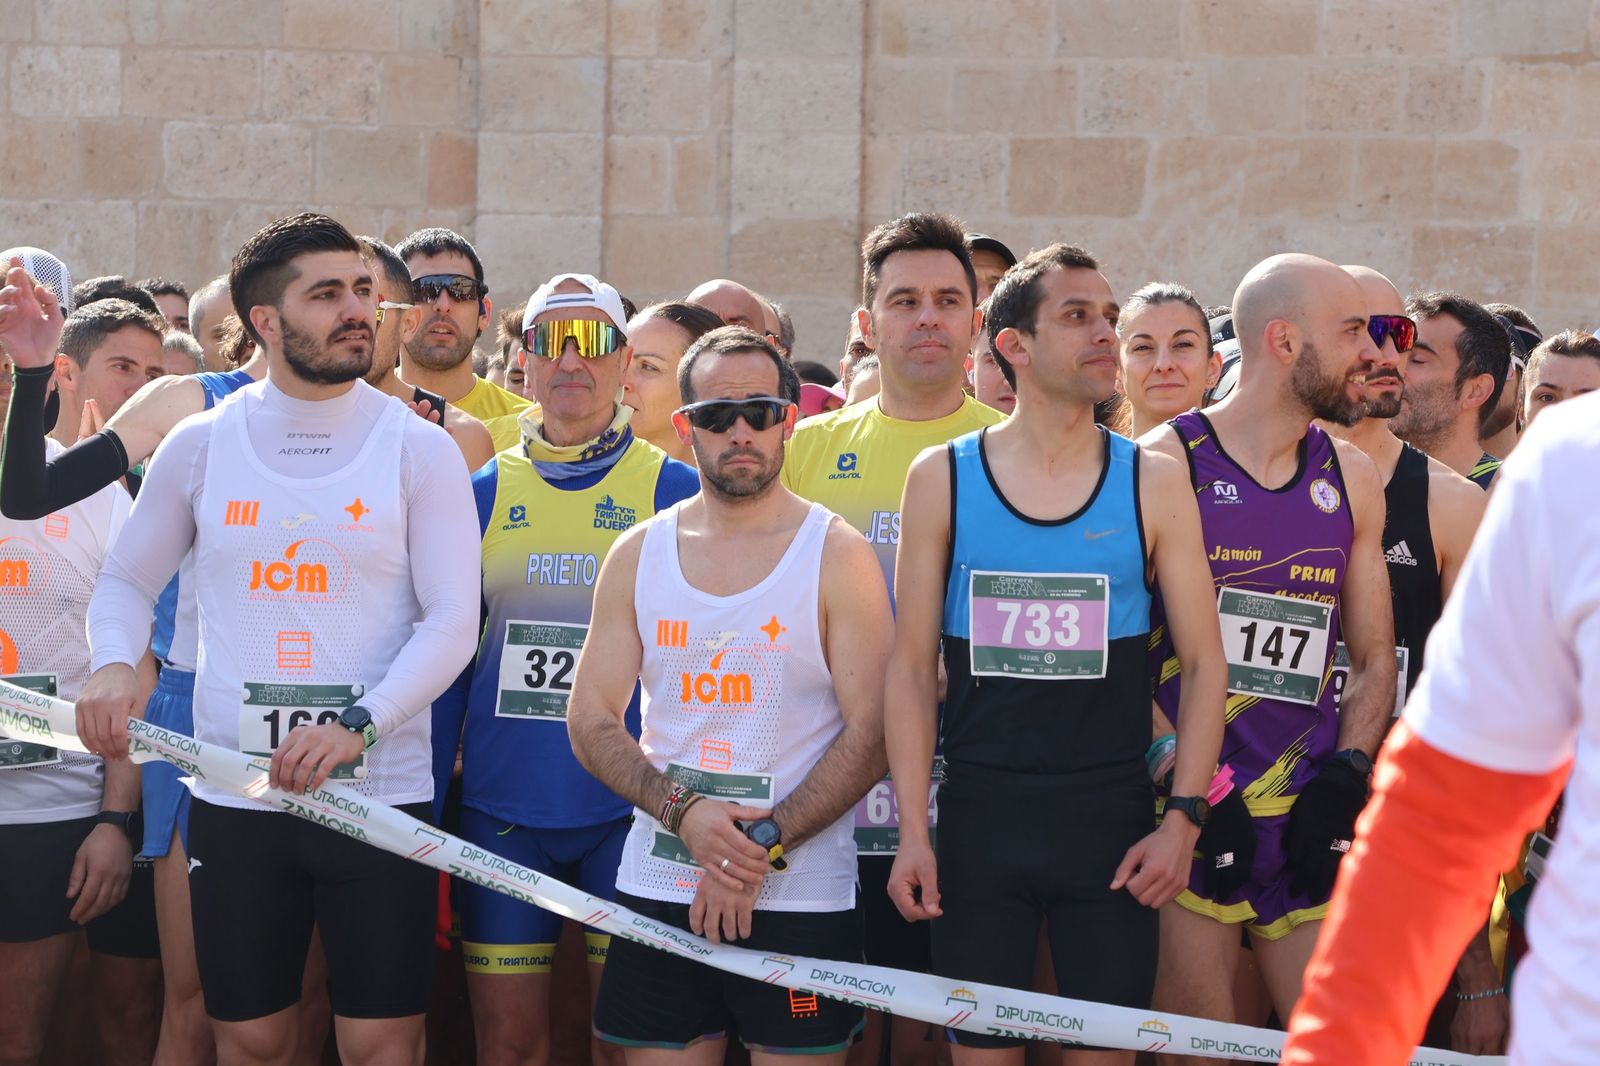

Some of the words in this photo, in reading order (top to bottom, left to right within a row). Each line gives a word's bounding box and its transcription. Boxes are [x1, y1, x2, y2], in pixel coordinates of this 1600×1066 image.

[595, 509, 636, 523] TRIATLON
[1209, 545, 1262, 561] Jamón
[1383, 554, 1417, 566] adidas
[526, 553, 598, 586] PRIETO
[1290, 565, 1336, 584] PRIM
[1246, 596, 1275, 605] Carrera
[1274, 589, 1337, 606] Macotera
[996, 601, 1080, 647] 733
[1240, 621, 1310, 669] 147
[524, 649, 575, 690] 32
[264, 684, 297, 692] Carrera
[263, 709, 339, 749] 16
[303, 784, 369, 819] PUTACION
[867, 783, 939, 825] 64
[281, 798, 368, 841] ZAMORA
[497, 957, 540, 967] TRIATLON
